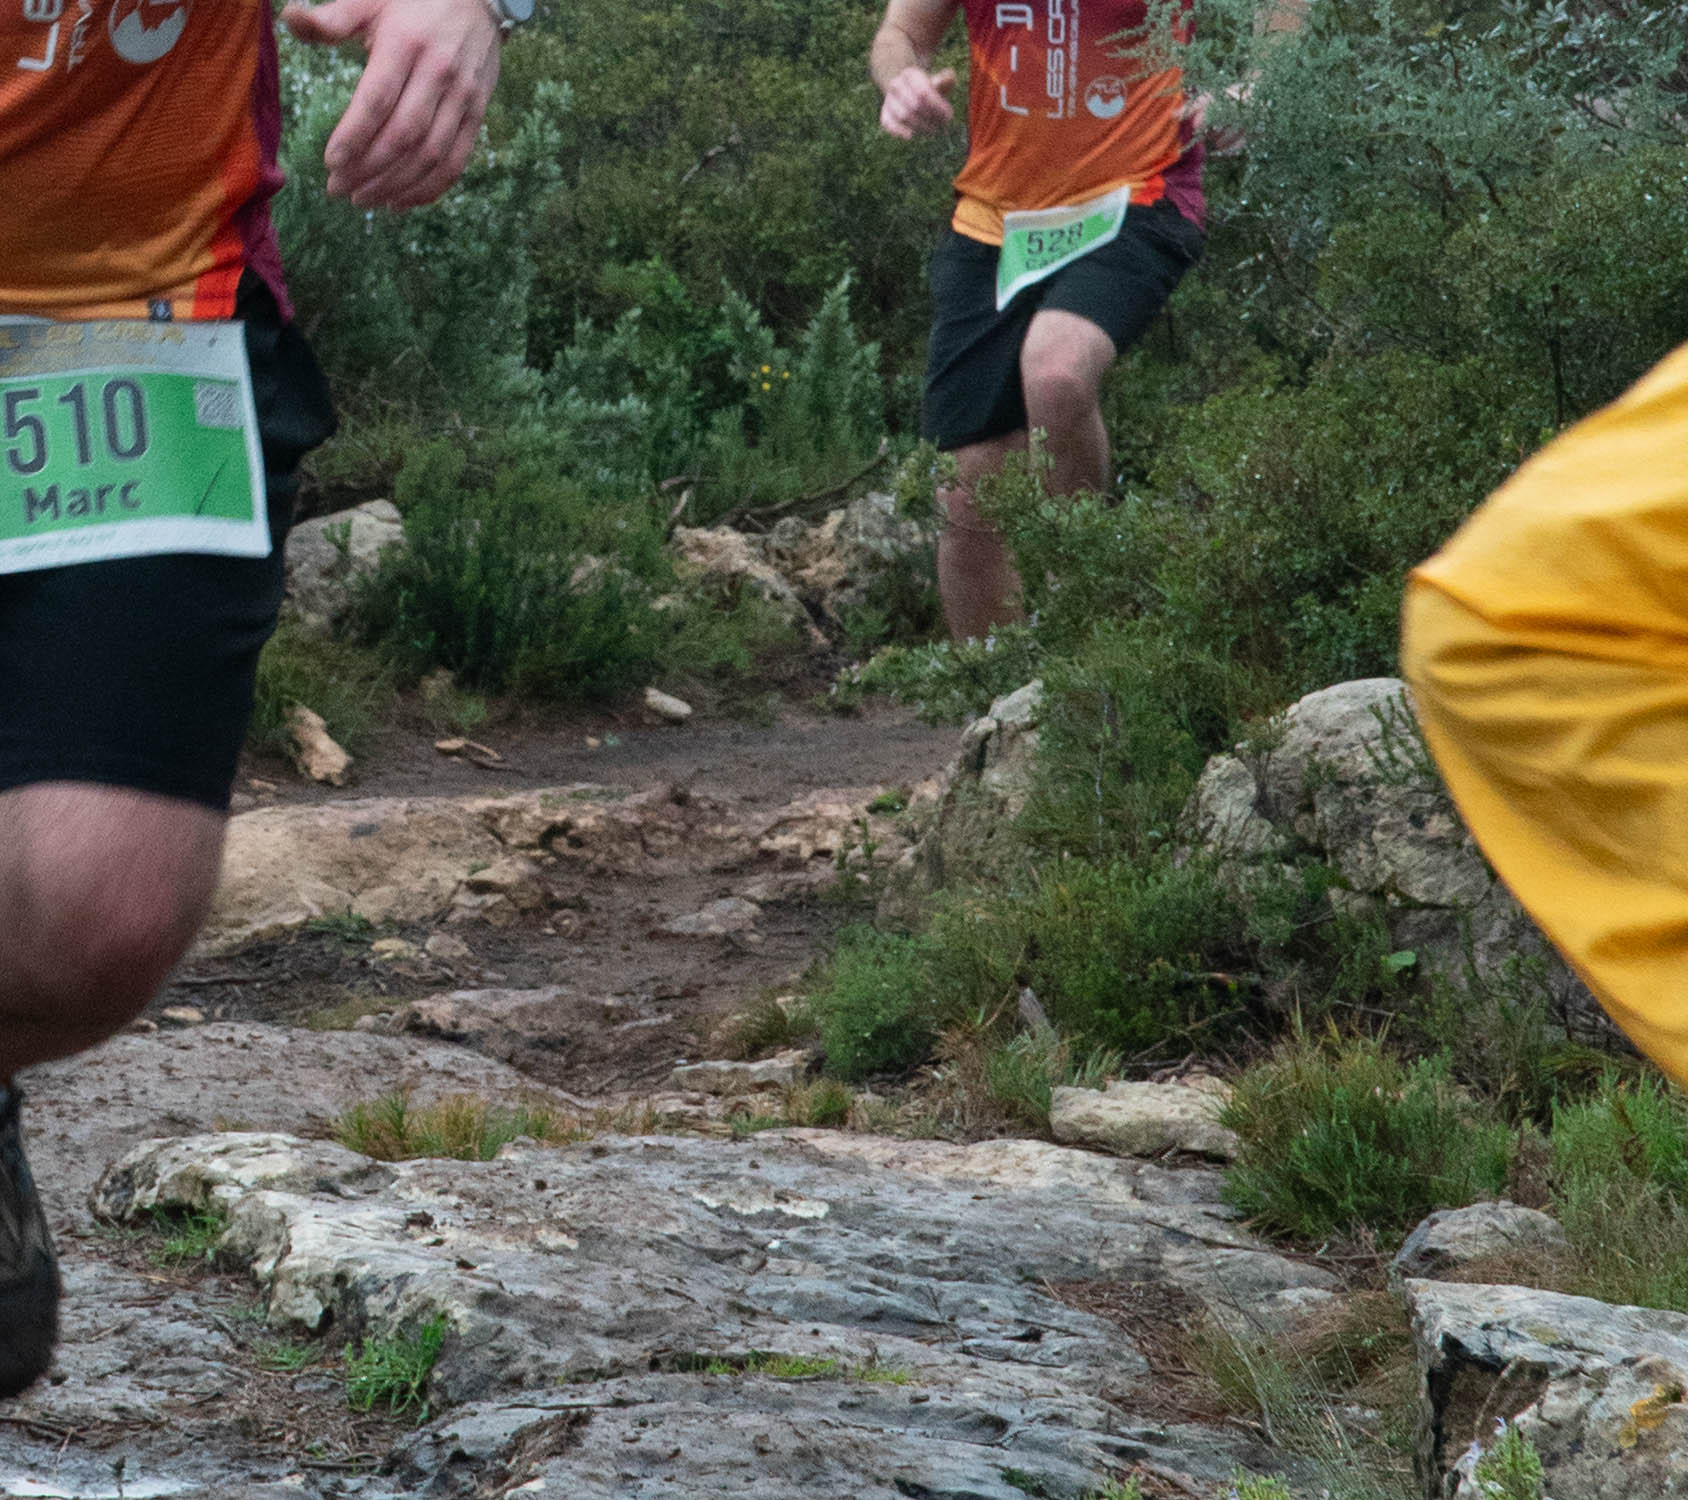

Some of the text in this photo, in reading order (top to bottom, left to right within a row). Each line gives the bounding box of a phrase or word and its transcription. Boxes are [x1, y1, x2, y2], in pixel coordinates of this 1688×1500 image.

[1046, 48, 1065, 119] LES
[3, 377, 149, 477] 510
[23, 480, 143, 525] Marc
